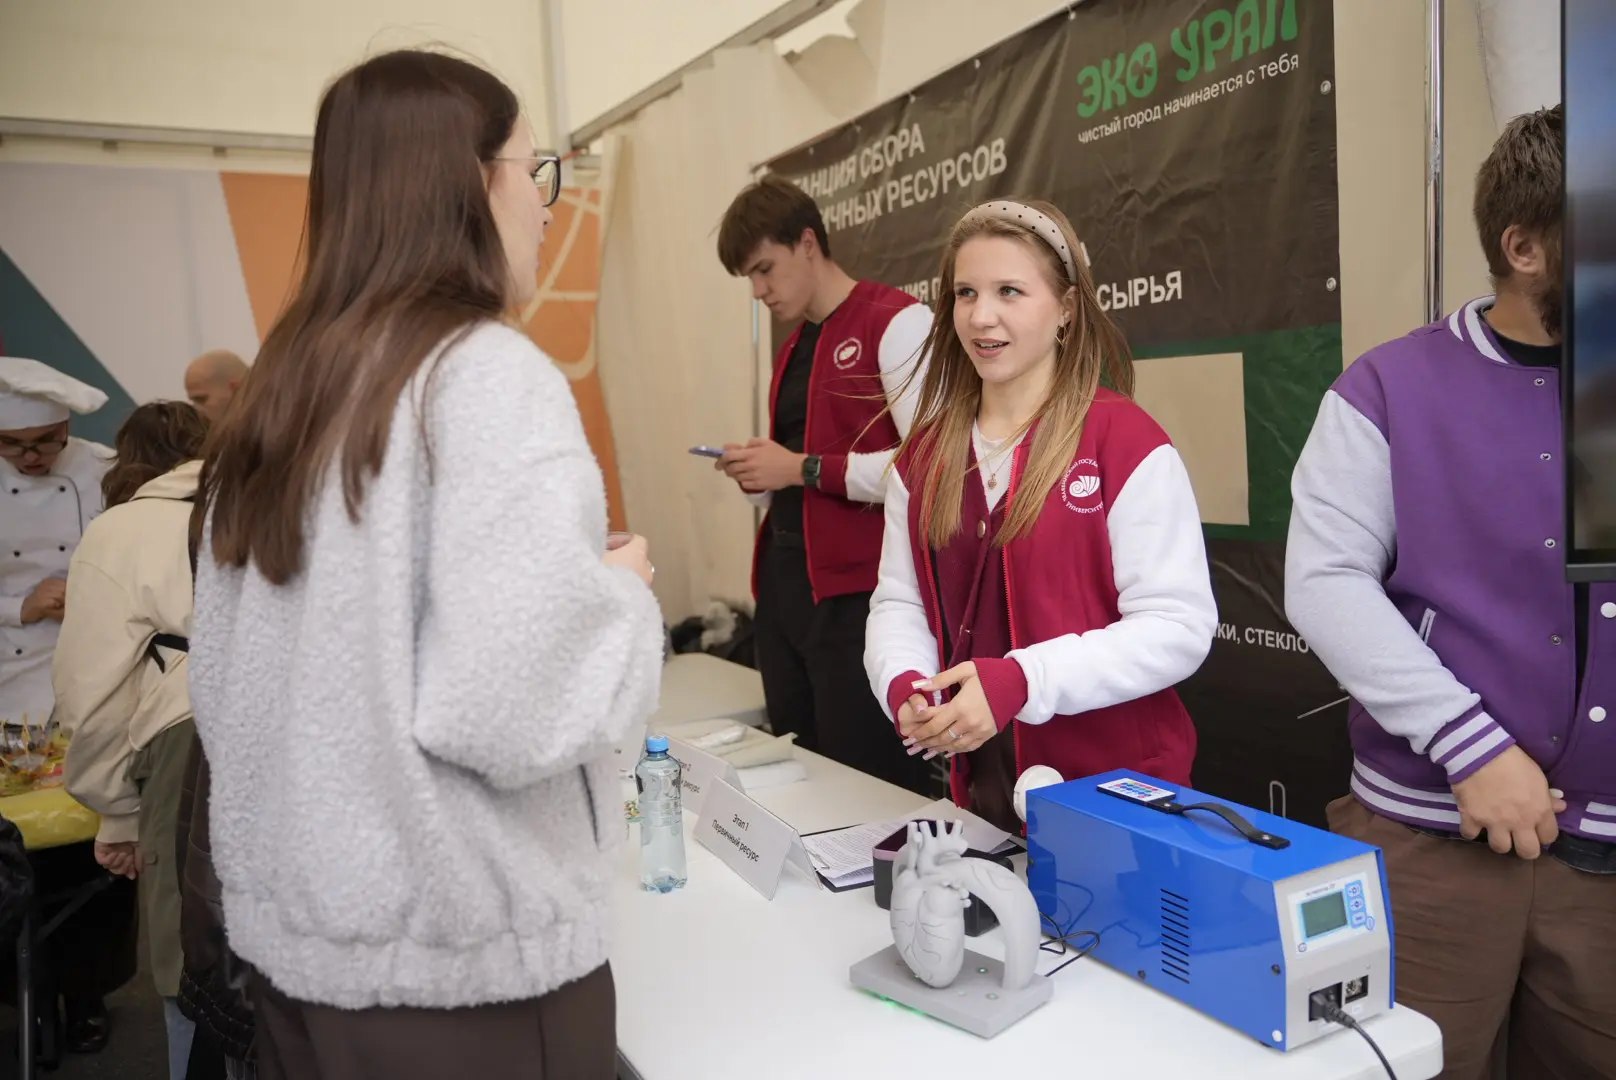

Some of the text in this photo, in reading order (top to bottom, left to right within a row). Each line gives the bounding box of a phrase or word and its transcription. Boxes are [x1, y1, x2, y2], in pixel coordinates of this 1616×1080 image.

[1076, 0, 1298, 118] ЭКО УРАЛ
[1078, 53, 1299, 144] чистый город начинается с тебя
[859, 123, 925, 179] СБОРА
[886, 137, 1008, 213] РЕСУРСОВ
[1096, 270, 1183, 312] СЫРЬЯ
[1213, 622, 1309, 653] КИ, СТЕКЛО
[712, 819, 759, 862] Первичный ресурс
[732, 814, 749, 831] Этап 1
